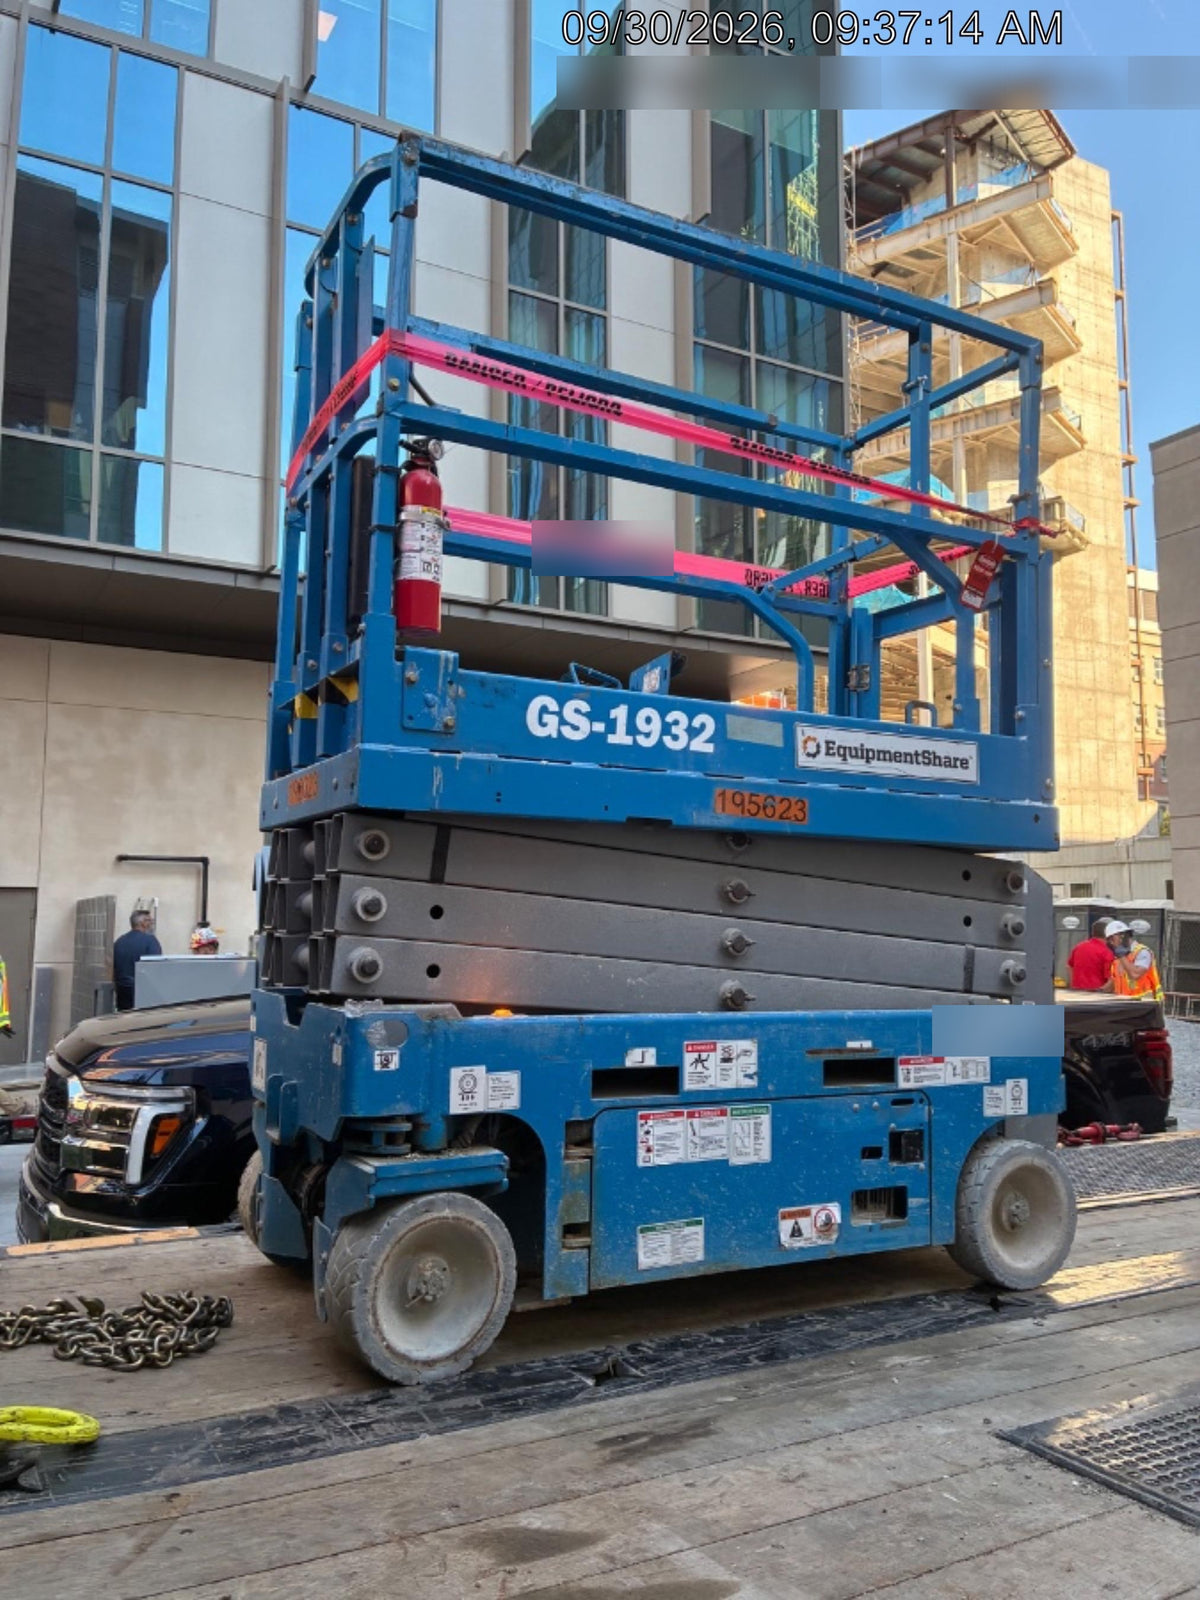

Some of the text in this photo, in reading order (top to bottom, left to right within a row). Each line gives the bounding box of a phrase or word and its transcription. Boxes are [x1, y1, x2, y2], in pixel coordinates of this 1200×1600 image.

[525, 695, 716, 753] GS-1932
[824, 740, 970, 770] EquipmentShare
[718, 788, 807, 822] 195623
